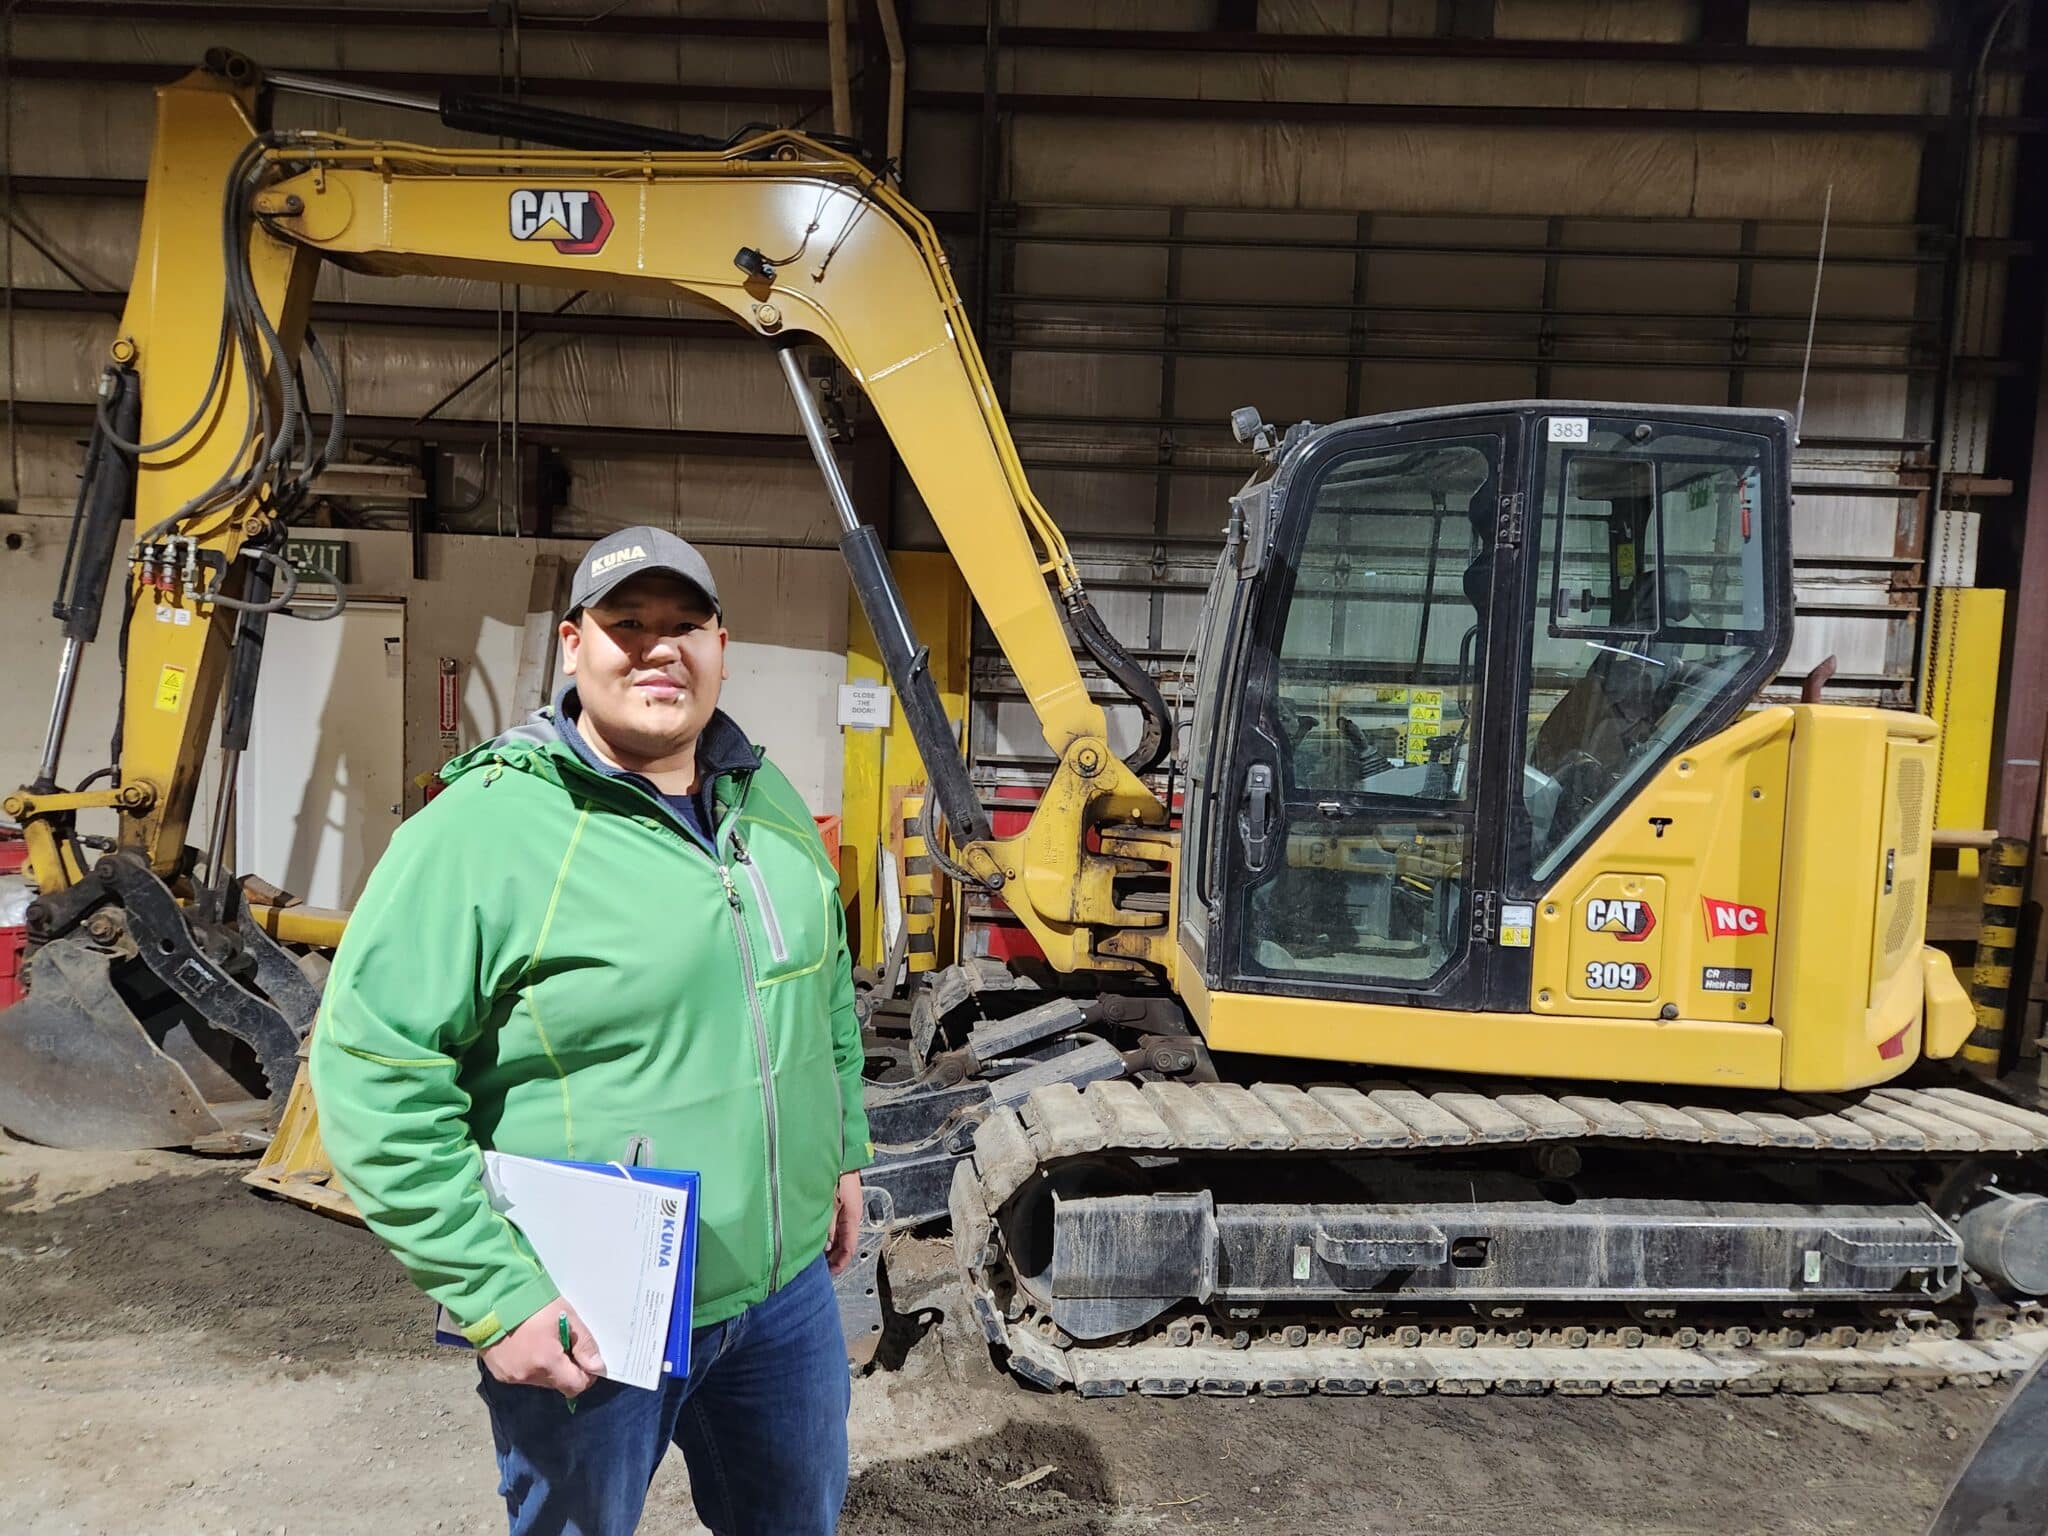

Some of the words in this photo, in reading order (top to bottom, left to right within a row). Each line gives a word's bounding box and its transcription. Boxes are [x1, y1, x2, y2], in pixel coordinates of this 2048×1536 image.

[510, 190, 589, 240] CAT
[1553, 423, 1583, 438] 383
[287, 544, 341, 576] EXIT
[591, 545, 647, 574] KUNA
[852, 691, 875, 699] CLOSE
[1587, 900, 1641, 933] CAT
[1715, 906, 1758, 932] NC
[1587, 962, 1637, 989] 309
[1705, 969, 1720, 979] CR
[658, 1218, 676, 1268] KUNA
